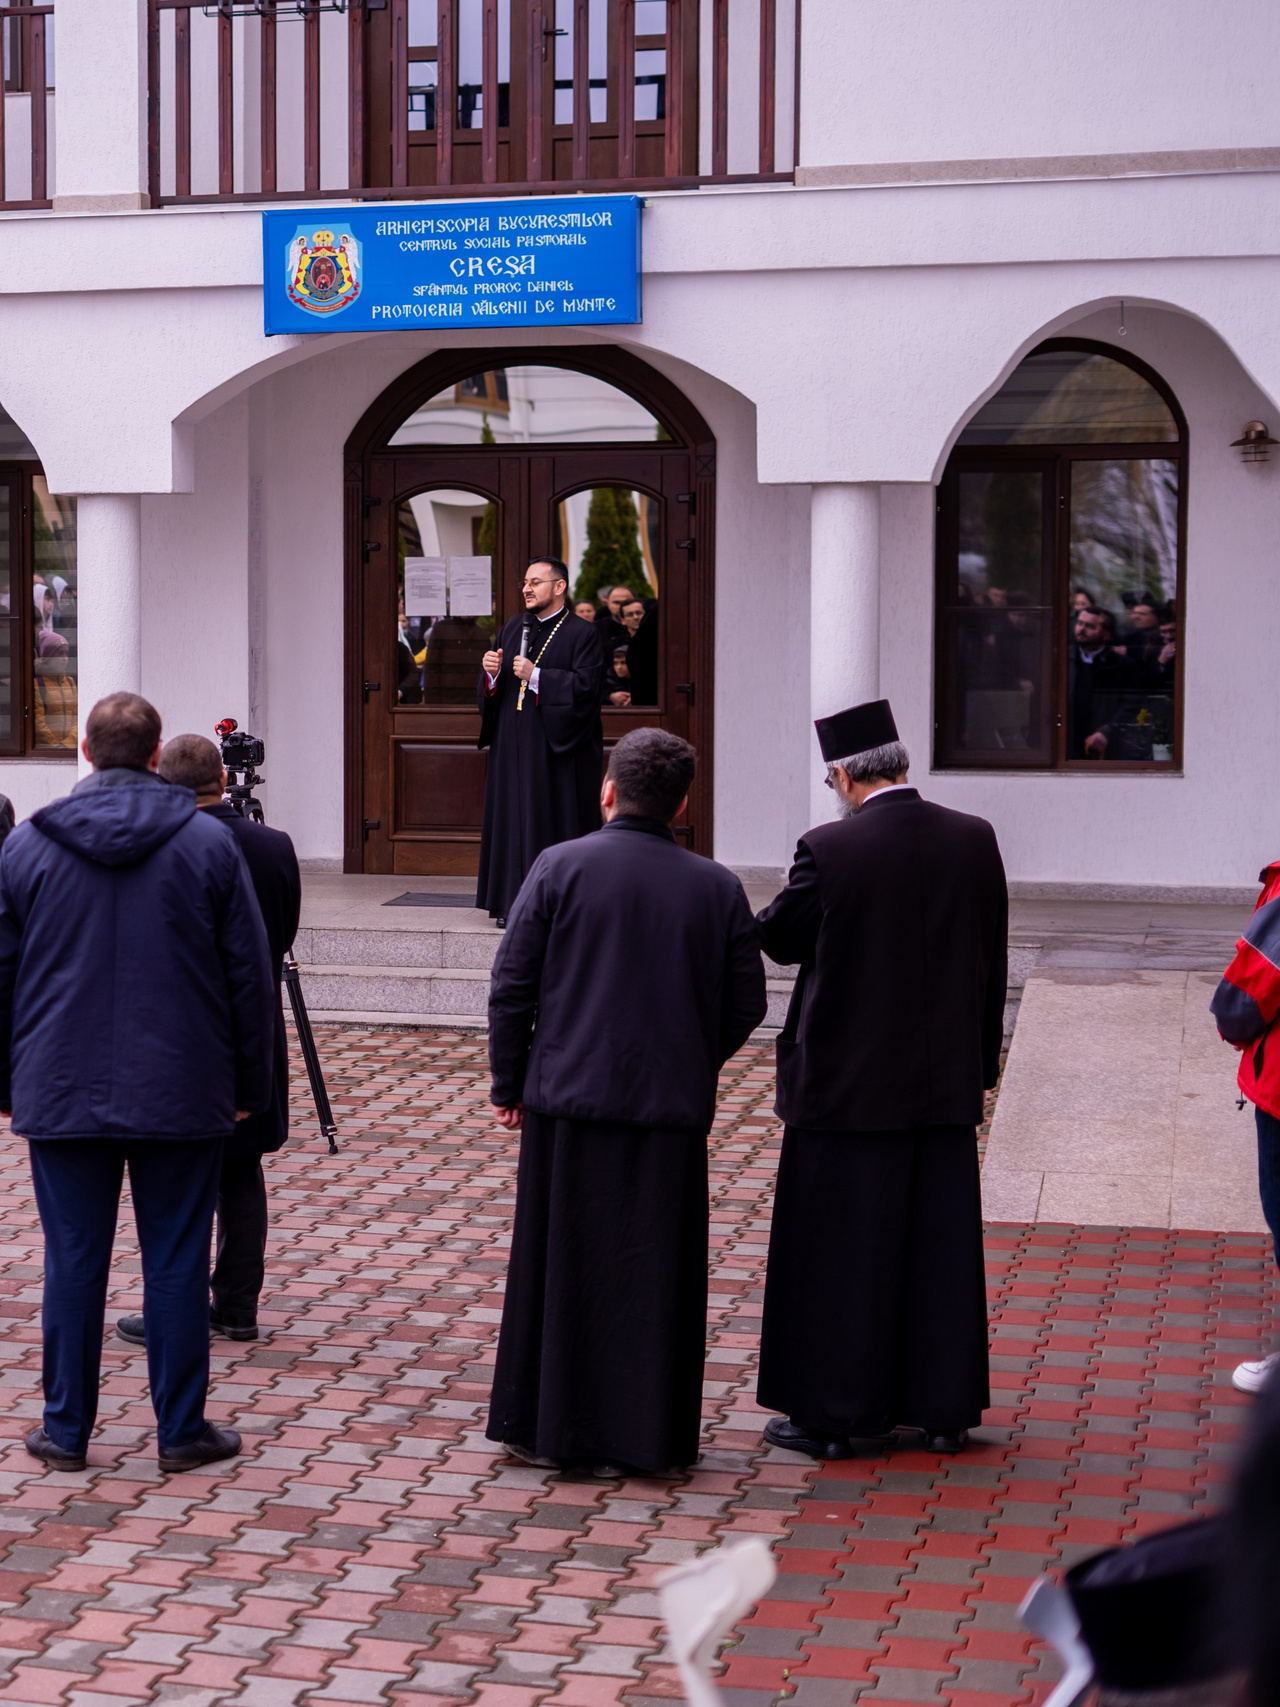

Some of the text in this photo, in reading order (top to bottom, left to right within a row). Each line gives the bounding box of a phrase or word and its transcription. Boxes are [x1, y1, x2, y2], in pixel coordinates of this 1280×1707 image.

[376, 218, 490, 236] ARHIEPISCOPIA
[400, 234, 586, 251] CENTRUL SOCIAL PASTORAL
[450, 255, 537, 278] CREȘA
[413, 281, 573, 296] SFÂNTUL PROROC DANIEL
[373, 298, 615, 318] PROTOIERIA VĂLENII DE MUNTE
